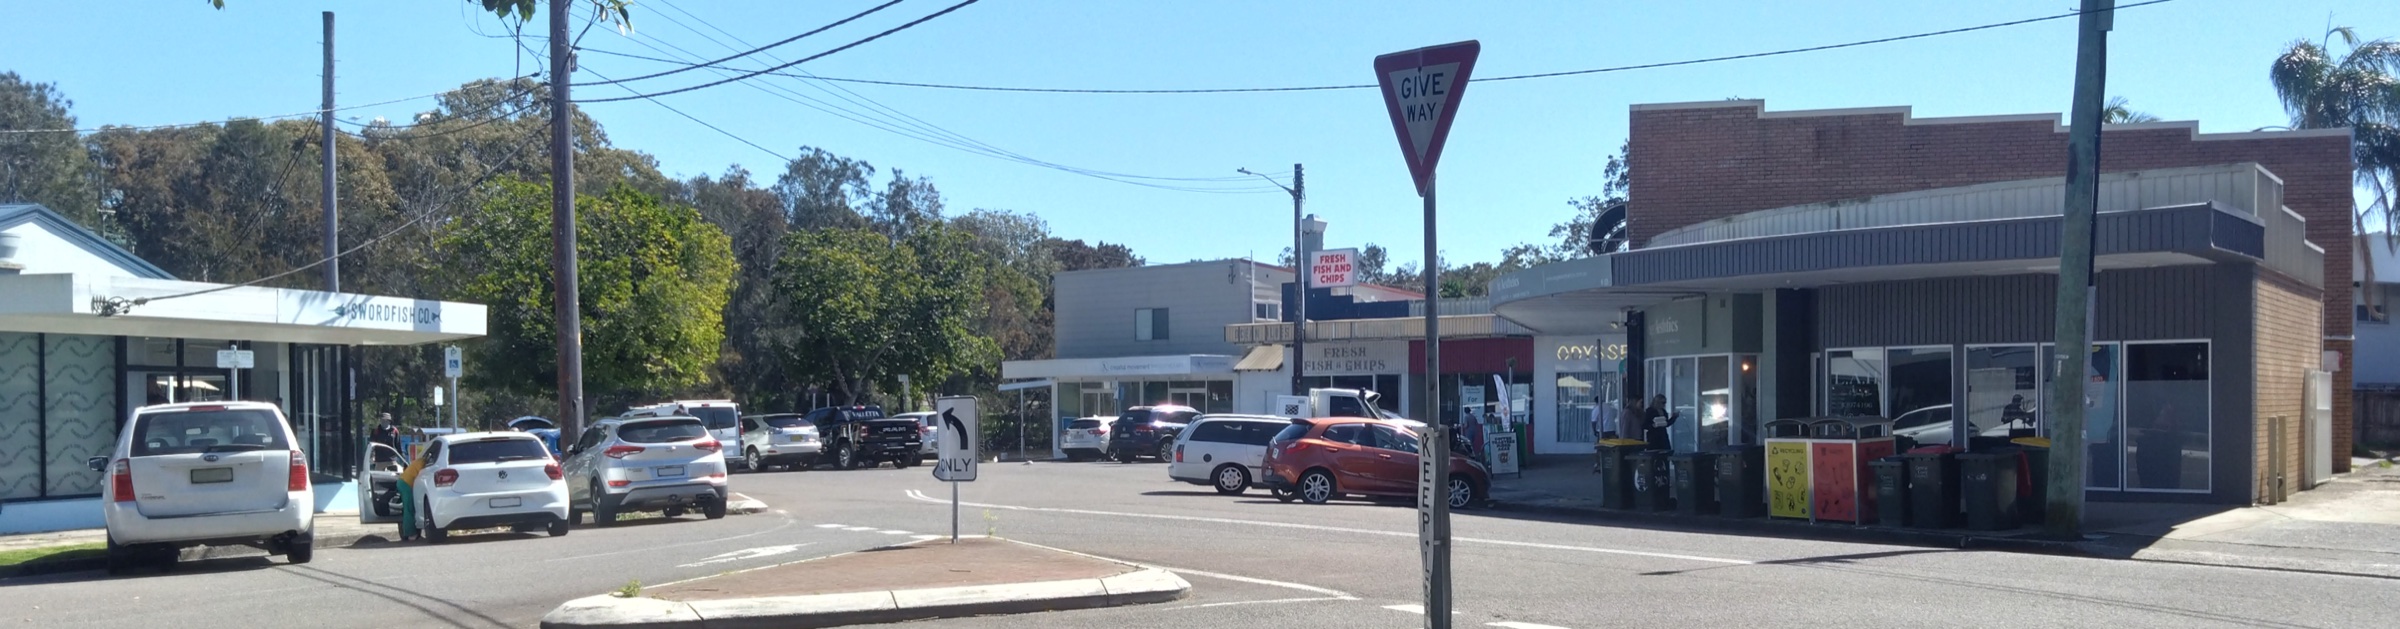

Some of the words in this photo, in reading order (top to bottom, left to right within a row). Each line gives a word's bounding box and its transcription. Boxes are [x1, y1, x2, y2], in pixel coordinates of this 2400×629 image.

[1401, 73, 1444, 99] GIVE
[1407, 102, 1437, 123] WAY
[1320, 254, 1346, 264] FRESH
[1313, 265, 1332, 275] FISH
[1334, 263, 1352, 273] AND
[1320, 273, 1345, 283] CHIPS
[351, 303, 415, 324] SWORDFISH
[418, 307, 432, 324] CO.
[1324, 347, 1366, 358] FRESH
[1304, 361, 1333, 371] FISH
[1345, 359, 1385, 371] CHIPS
[941, 458, 972, 472] ONLY
[1422, 434, 1431, 533] KEEP
